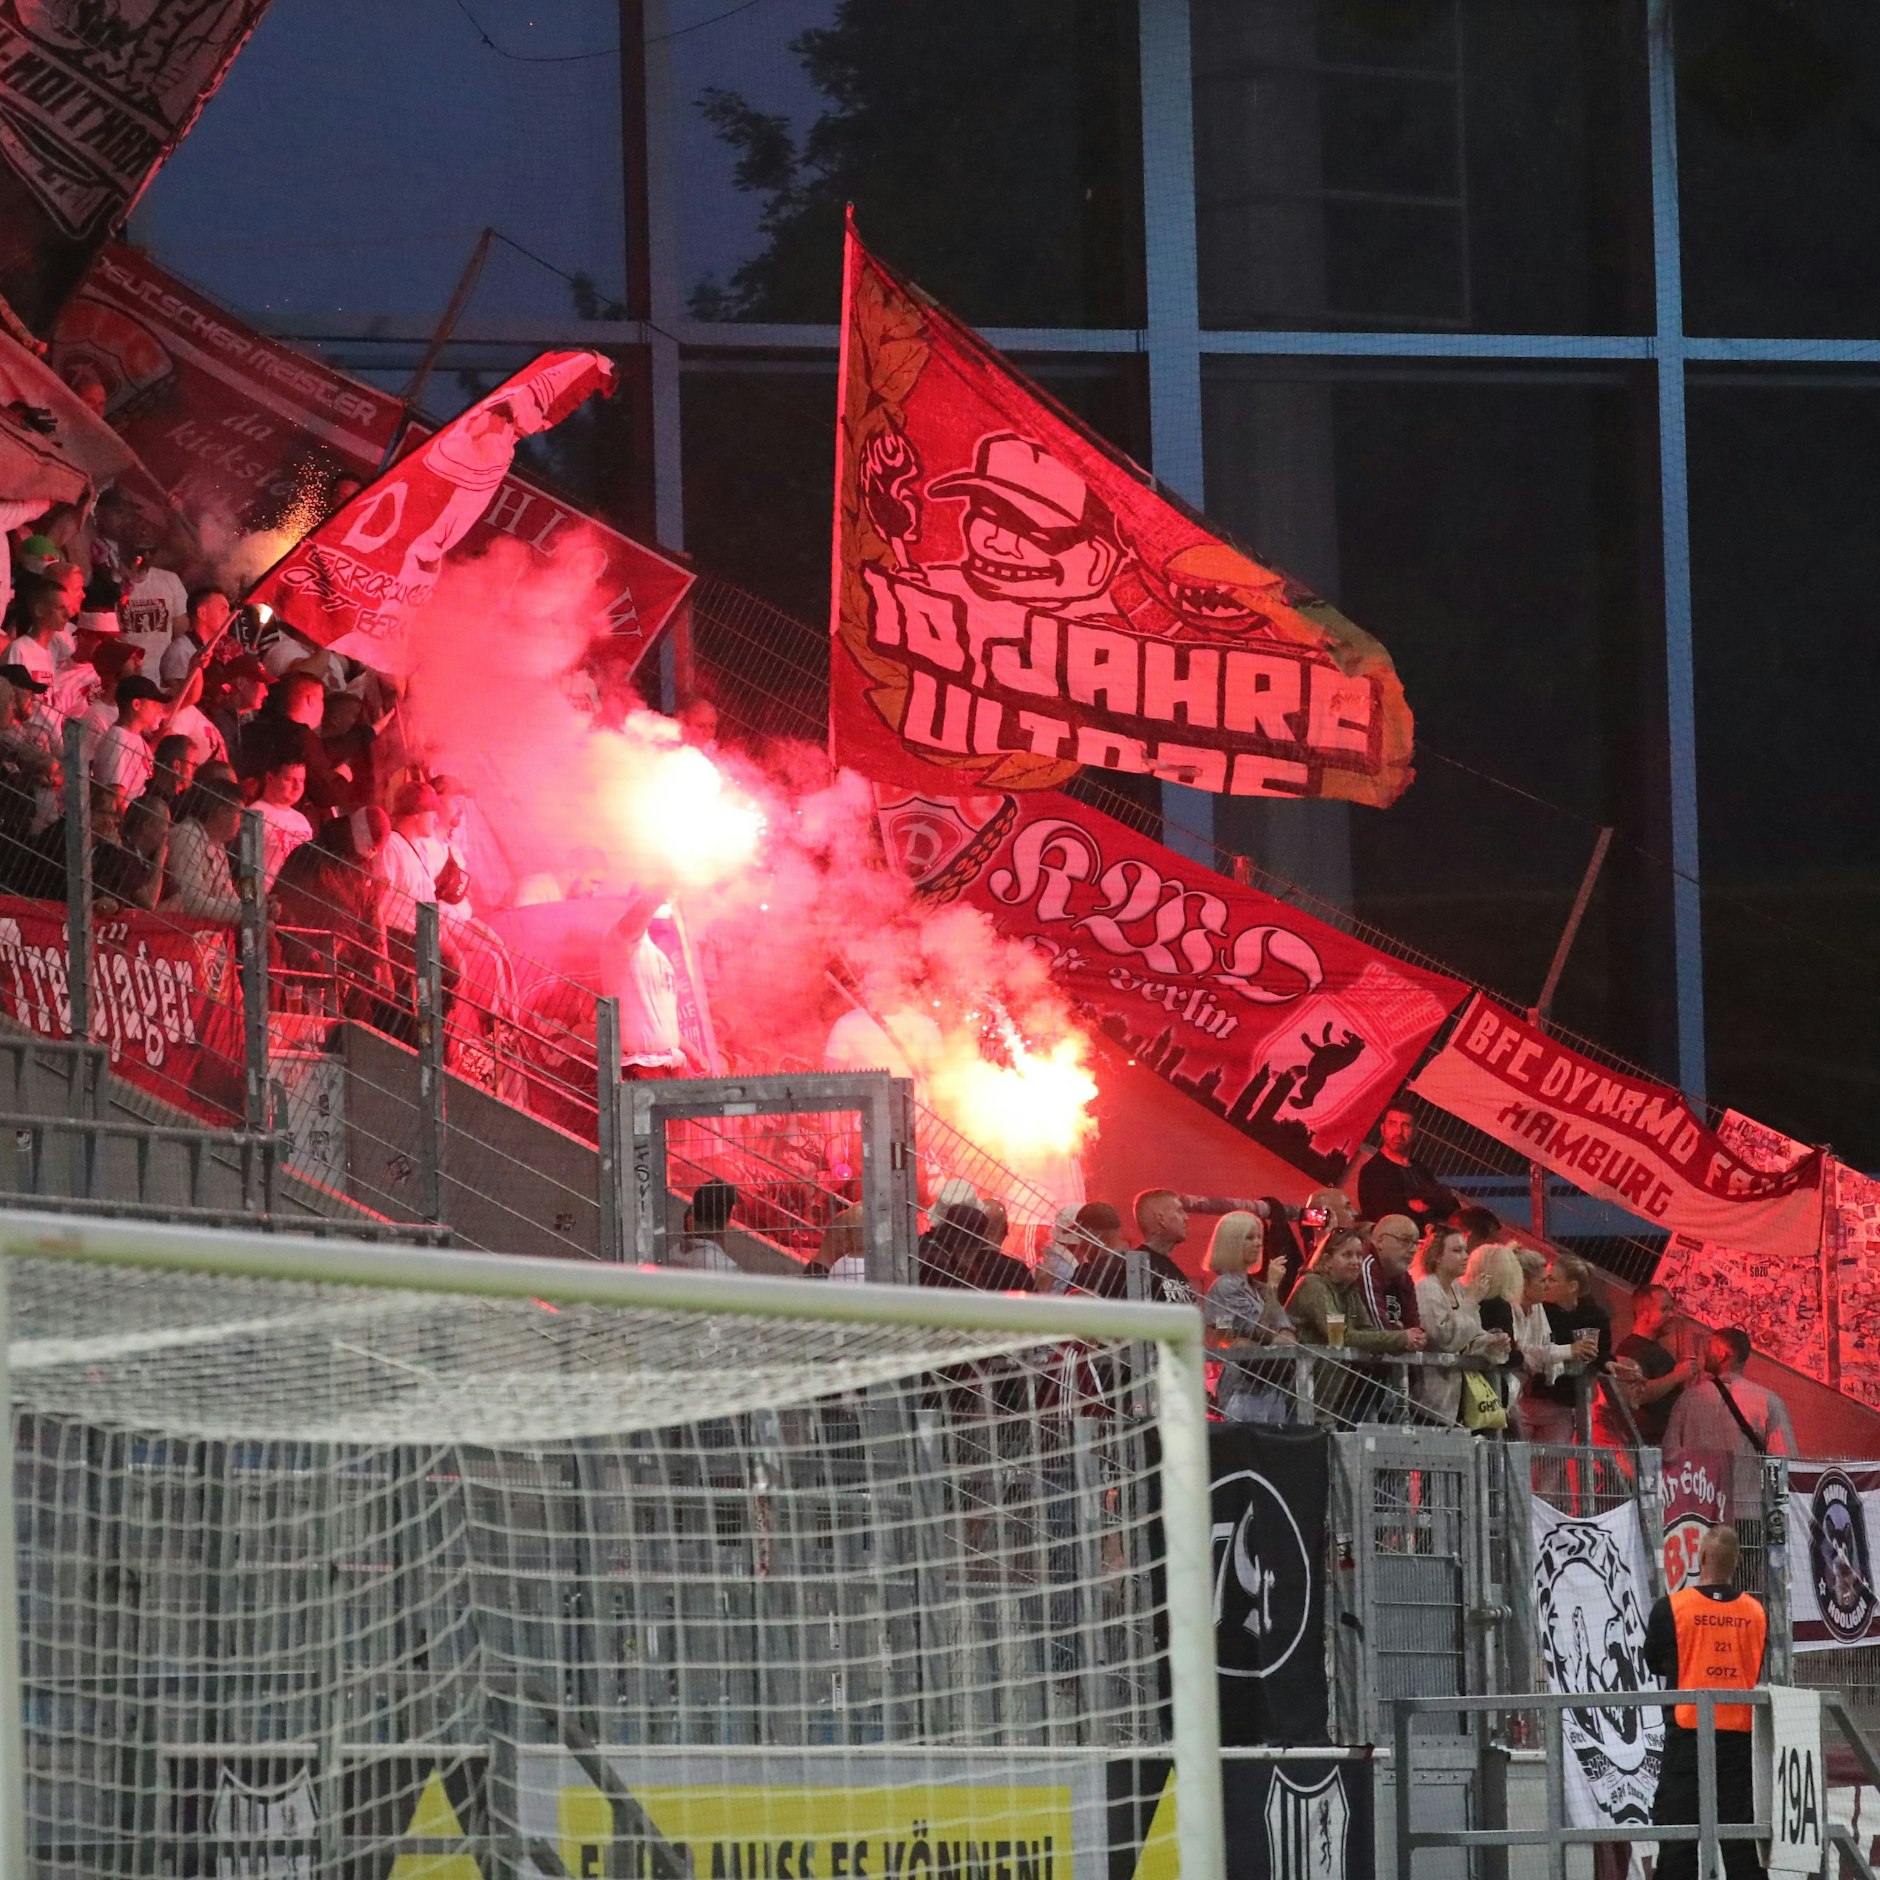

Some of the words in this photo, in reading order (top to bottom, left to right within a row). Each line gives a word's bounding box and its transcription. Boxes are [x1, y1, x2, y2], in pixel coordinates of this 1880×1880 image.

[991, 612, 1372, 754] JAHRE
[1108, 967, 1240, 1040] Berlin
[1467, 1010, 1544, 1084] BFC
[1541, 1055, 1701, 1165] DYNAMO
[1497, 1102, 1673, 1219] HAMBURG
[1693, 1615, 1752, 1628] SECURITY
[1714, 1641, 1732, 1652] 221
[1827, 1595, 1868, 1630] HOOLIGAN
[1778, 1746, 1819, 1846] 19A
